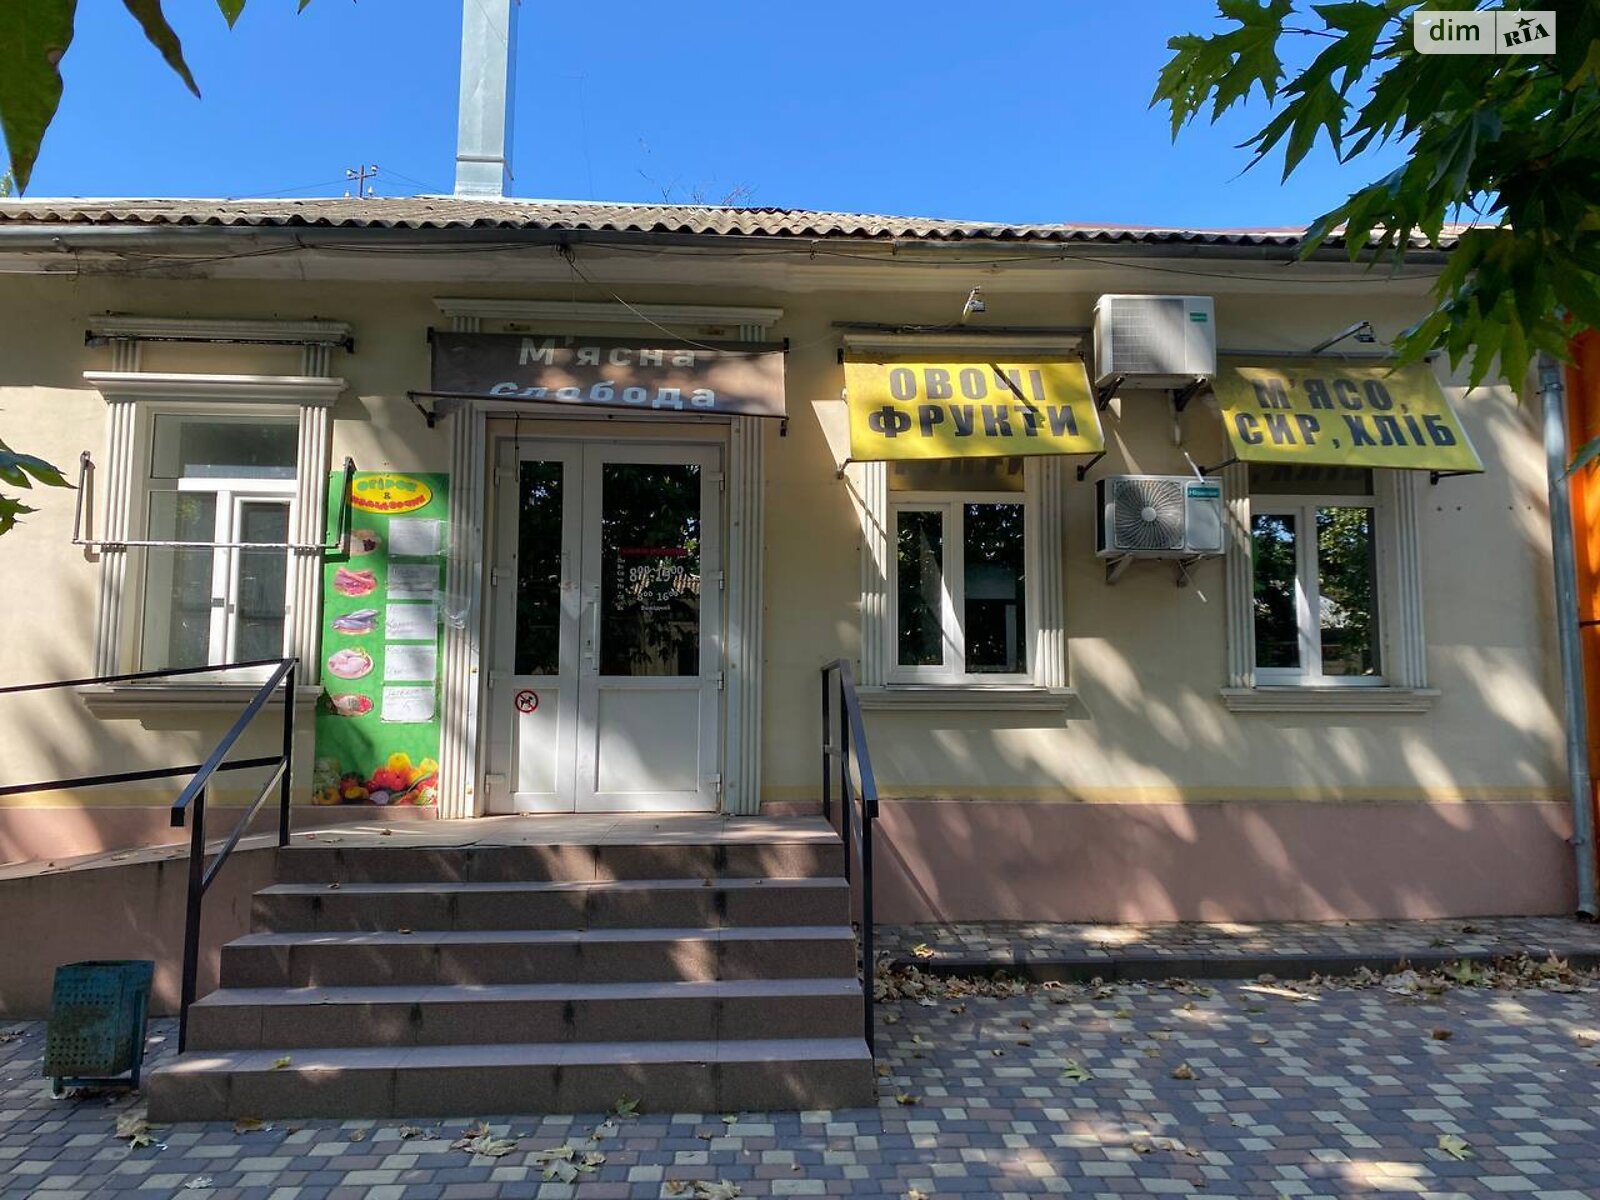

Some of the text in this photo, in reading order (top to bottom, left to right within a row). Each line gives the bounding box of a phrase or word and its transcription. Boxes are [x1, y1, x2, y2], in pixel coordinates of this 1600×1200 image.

[519, 337, 697, 367] М'ясна
[889, 367, 1046, 401] ОВОЧІ
[868, 404, 1080, 438] ФРУКТИ
[1341, 414, 1457, 446] ХЛІБ
